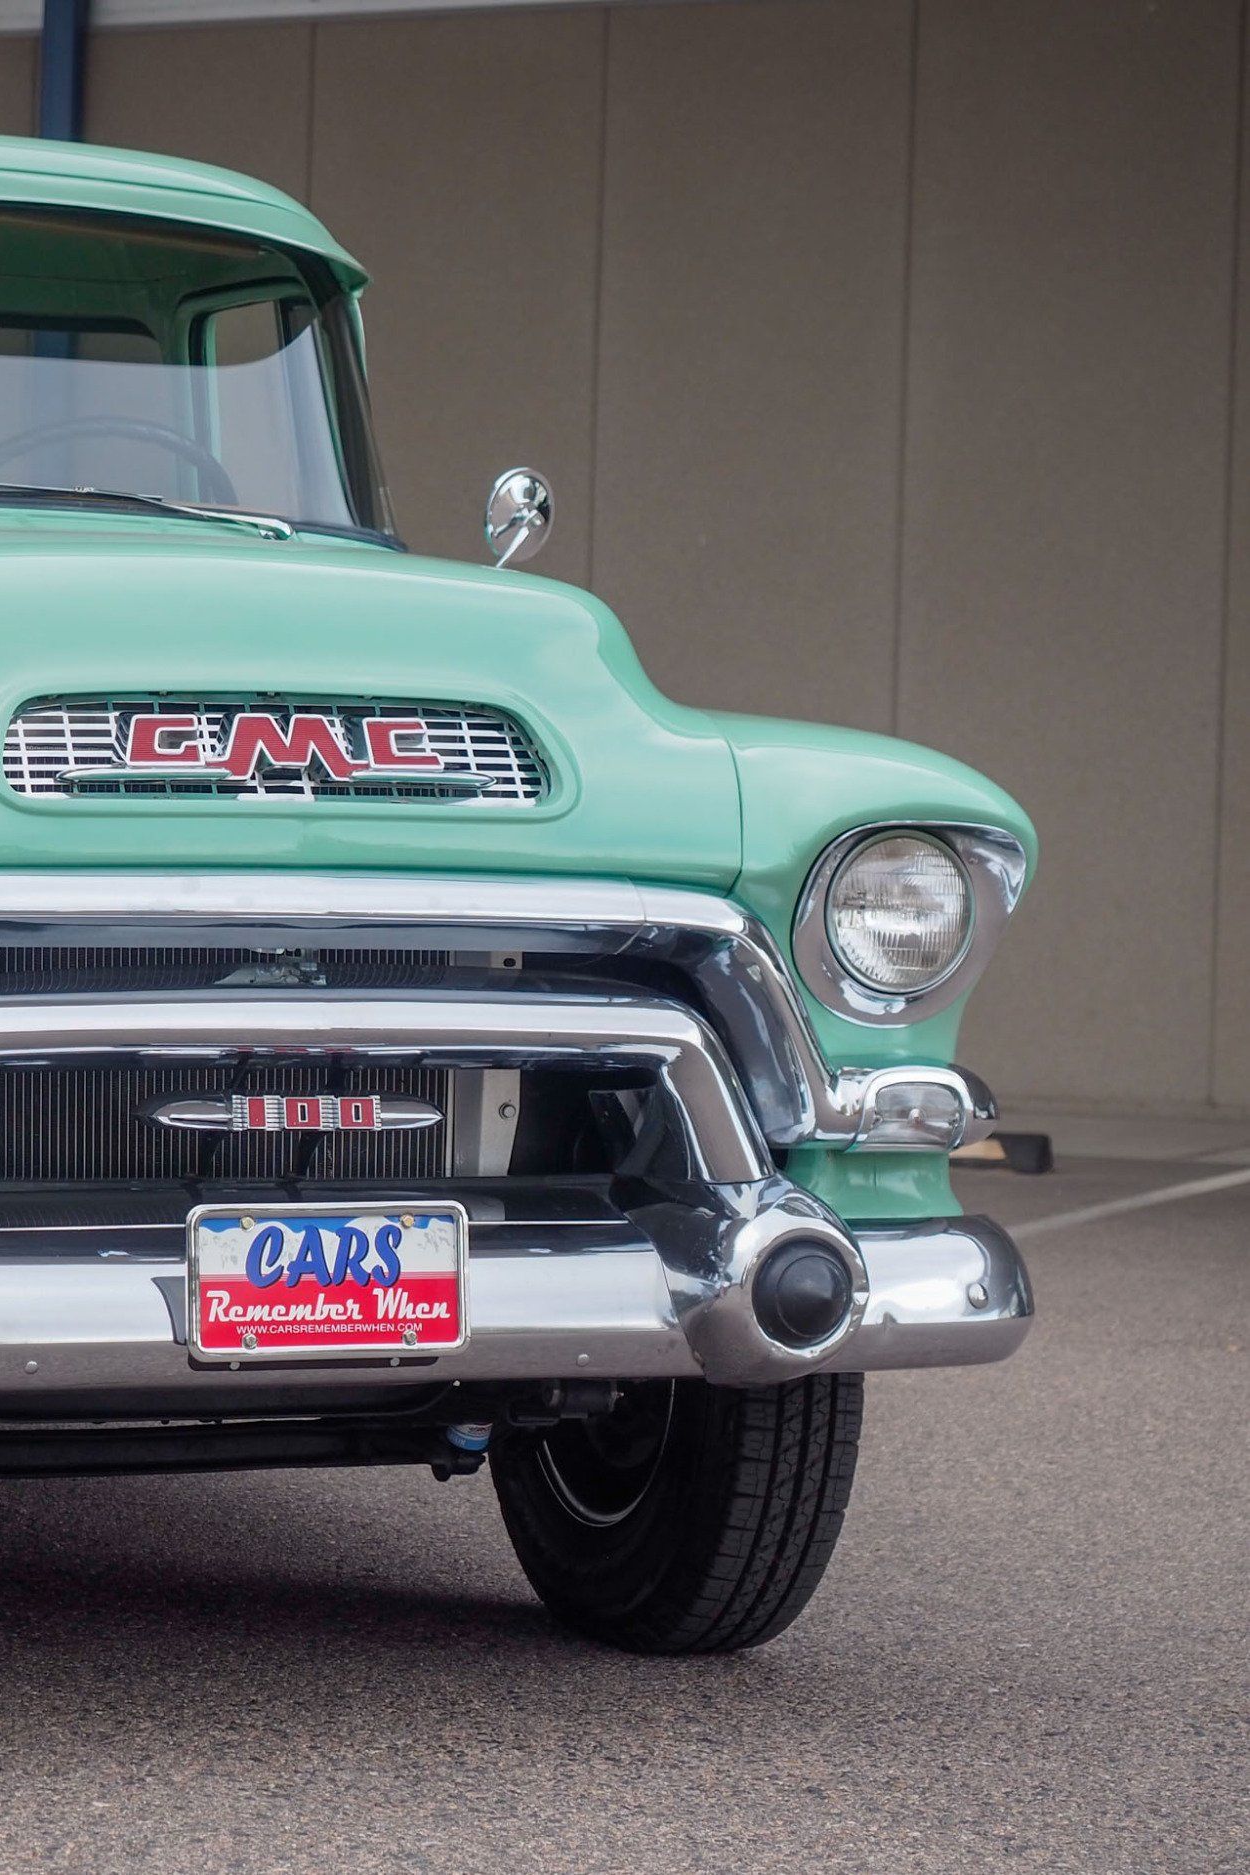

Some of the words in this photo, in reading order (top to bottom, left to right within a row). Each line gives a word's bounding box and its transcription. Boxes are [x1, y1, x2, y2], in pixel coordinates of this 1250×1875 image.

[124, 713, 445, 782] GMC
[246, 1096, 376, 1130] 100
[245, 1224, 403, 1289] CARS
[206, 1290, 363, 1323] Remember
[372, 1287, 450, 1320] When
[236, 1322, 423, 1334] WWW.CARSREMEMBERWHEN.COM
